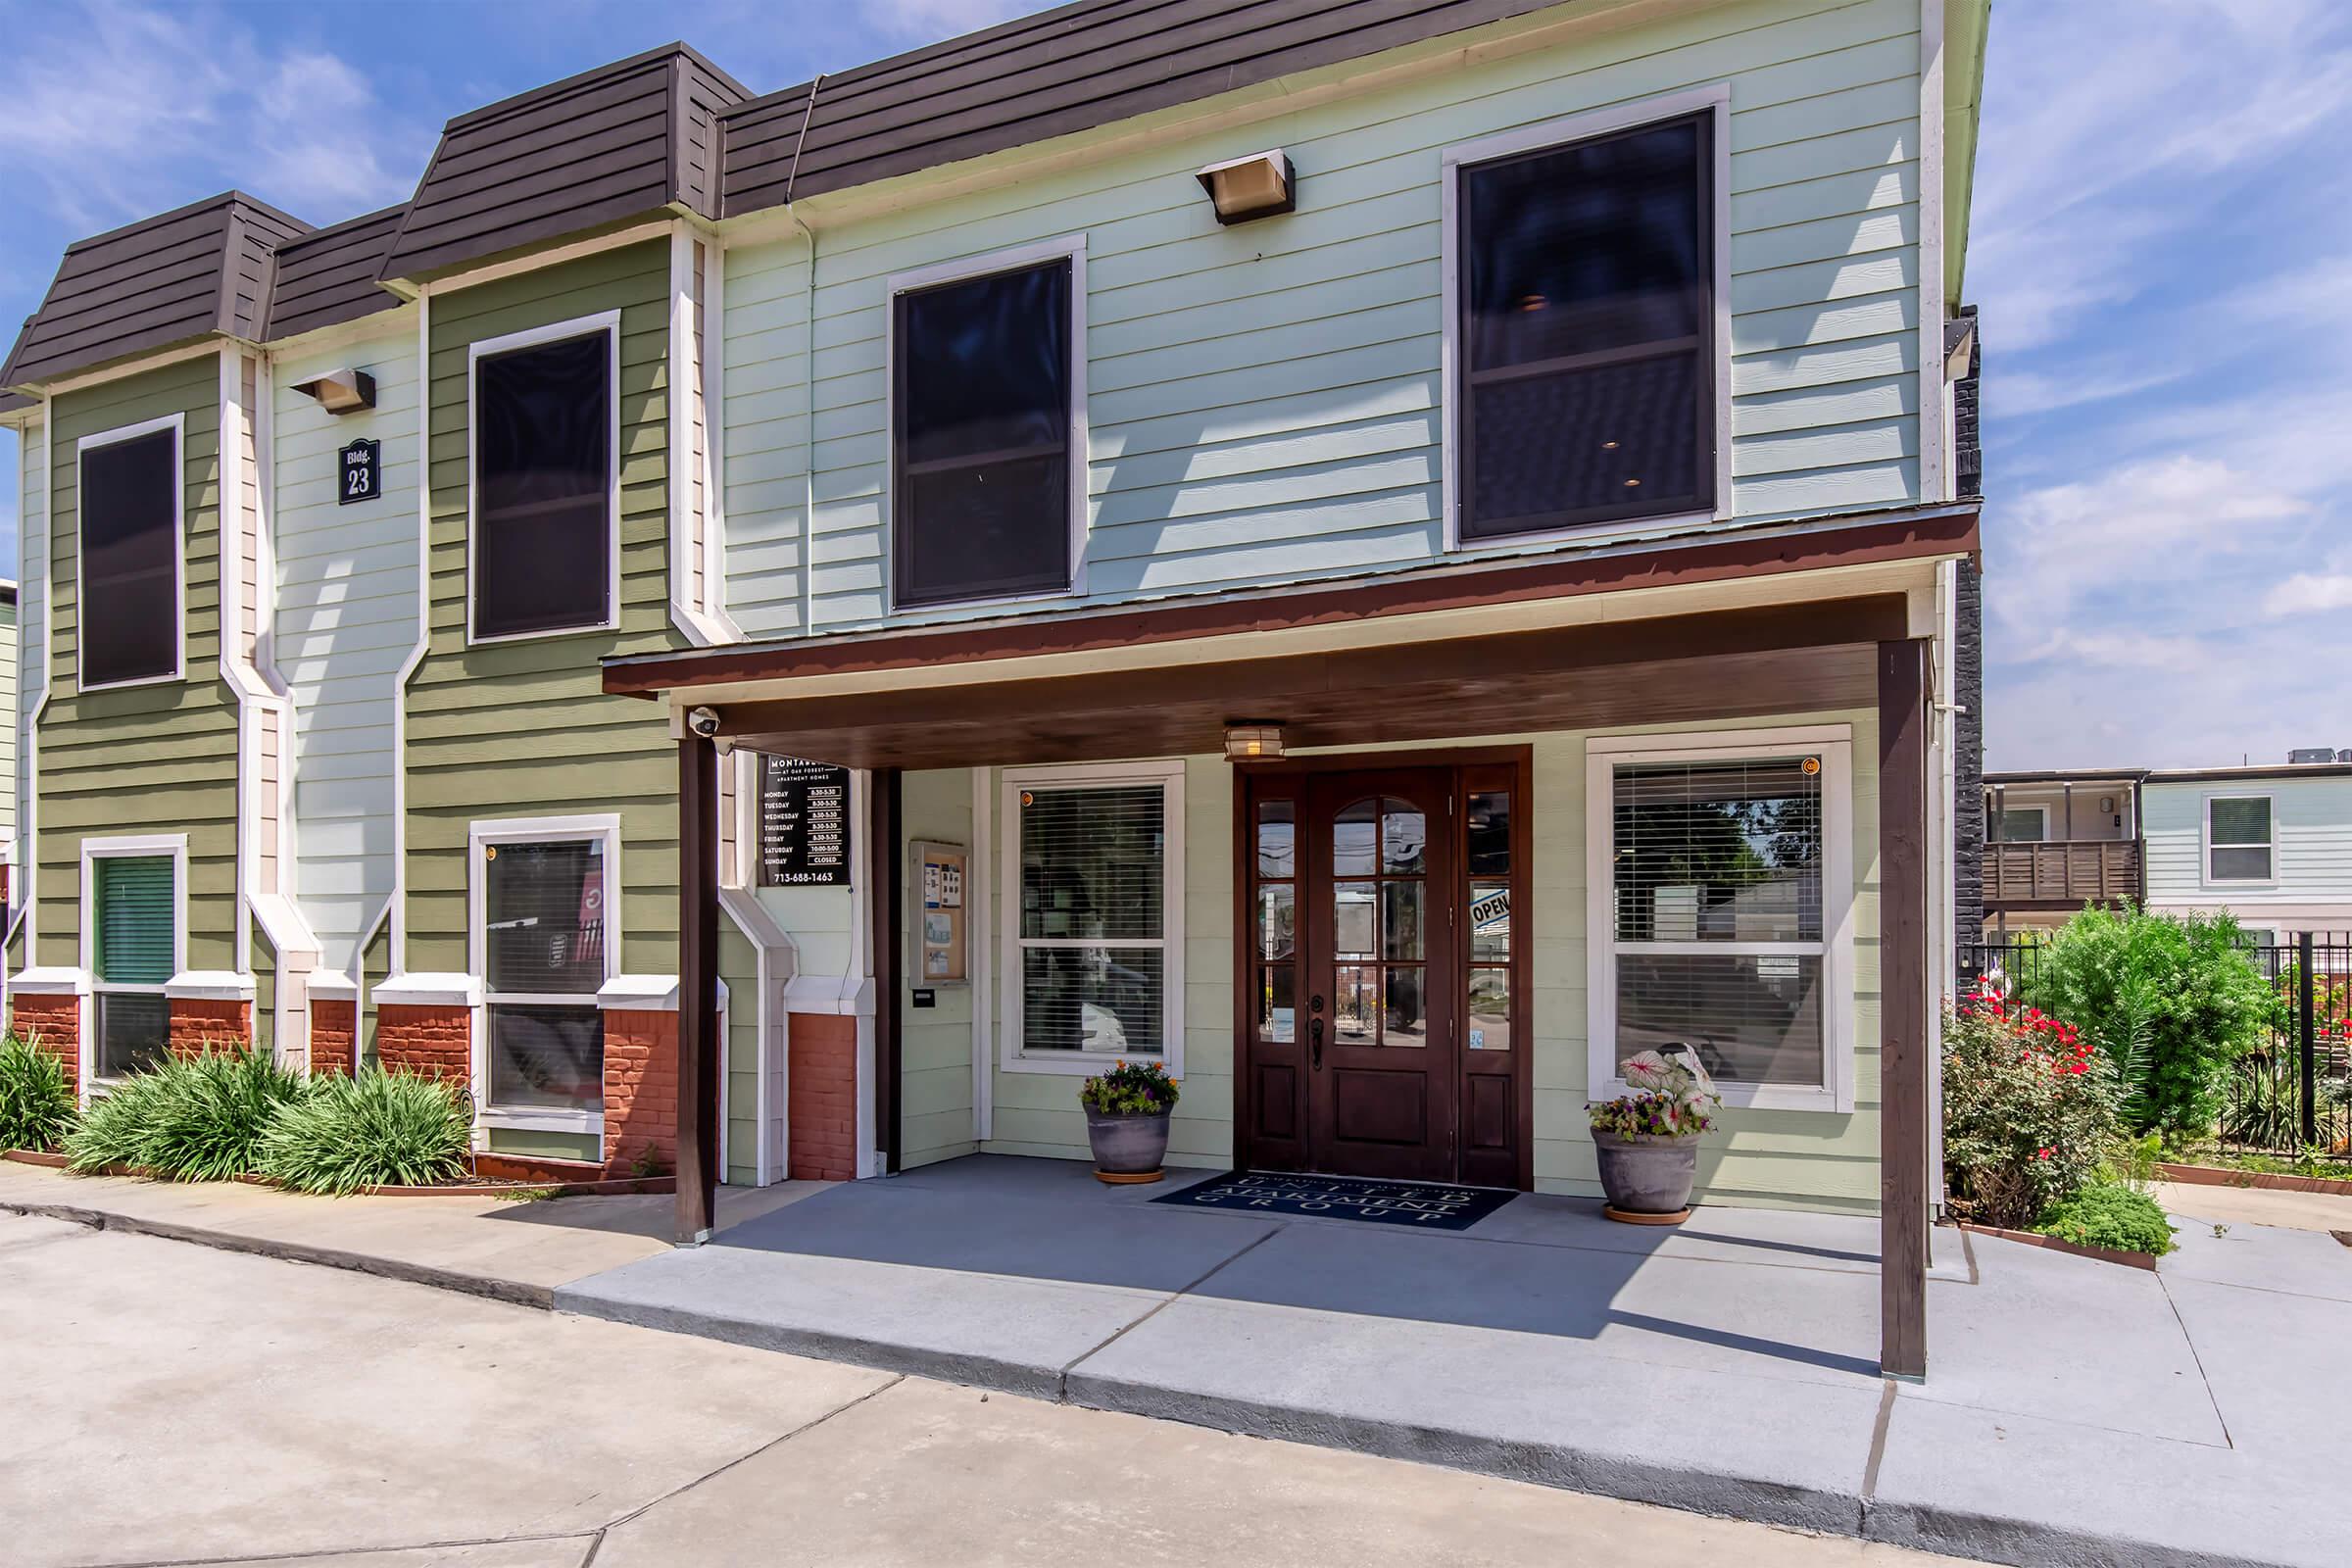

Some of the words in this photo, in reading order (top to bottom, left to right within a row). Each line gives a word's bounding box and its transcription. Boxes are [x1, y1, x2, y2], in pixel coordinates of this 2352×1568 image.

[347, 450, 370, 465] Bldg.
[348, 467, 369, 495] 23
[774, 872, 833, 882] 713-688-1463
[1473, 895, 1510, 921] OPEN
[1211, 1187, 1460, 1211] APARTMENT
[1238, 1178, 1471, 1202] UNITED
[1195, 1195, 1442, 1221] GROUP
